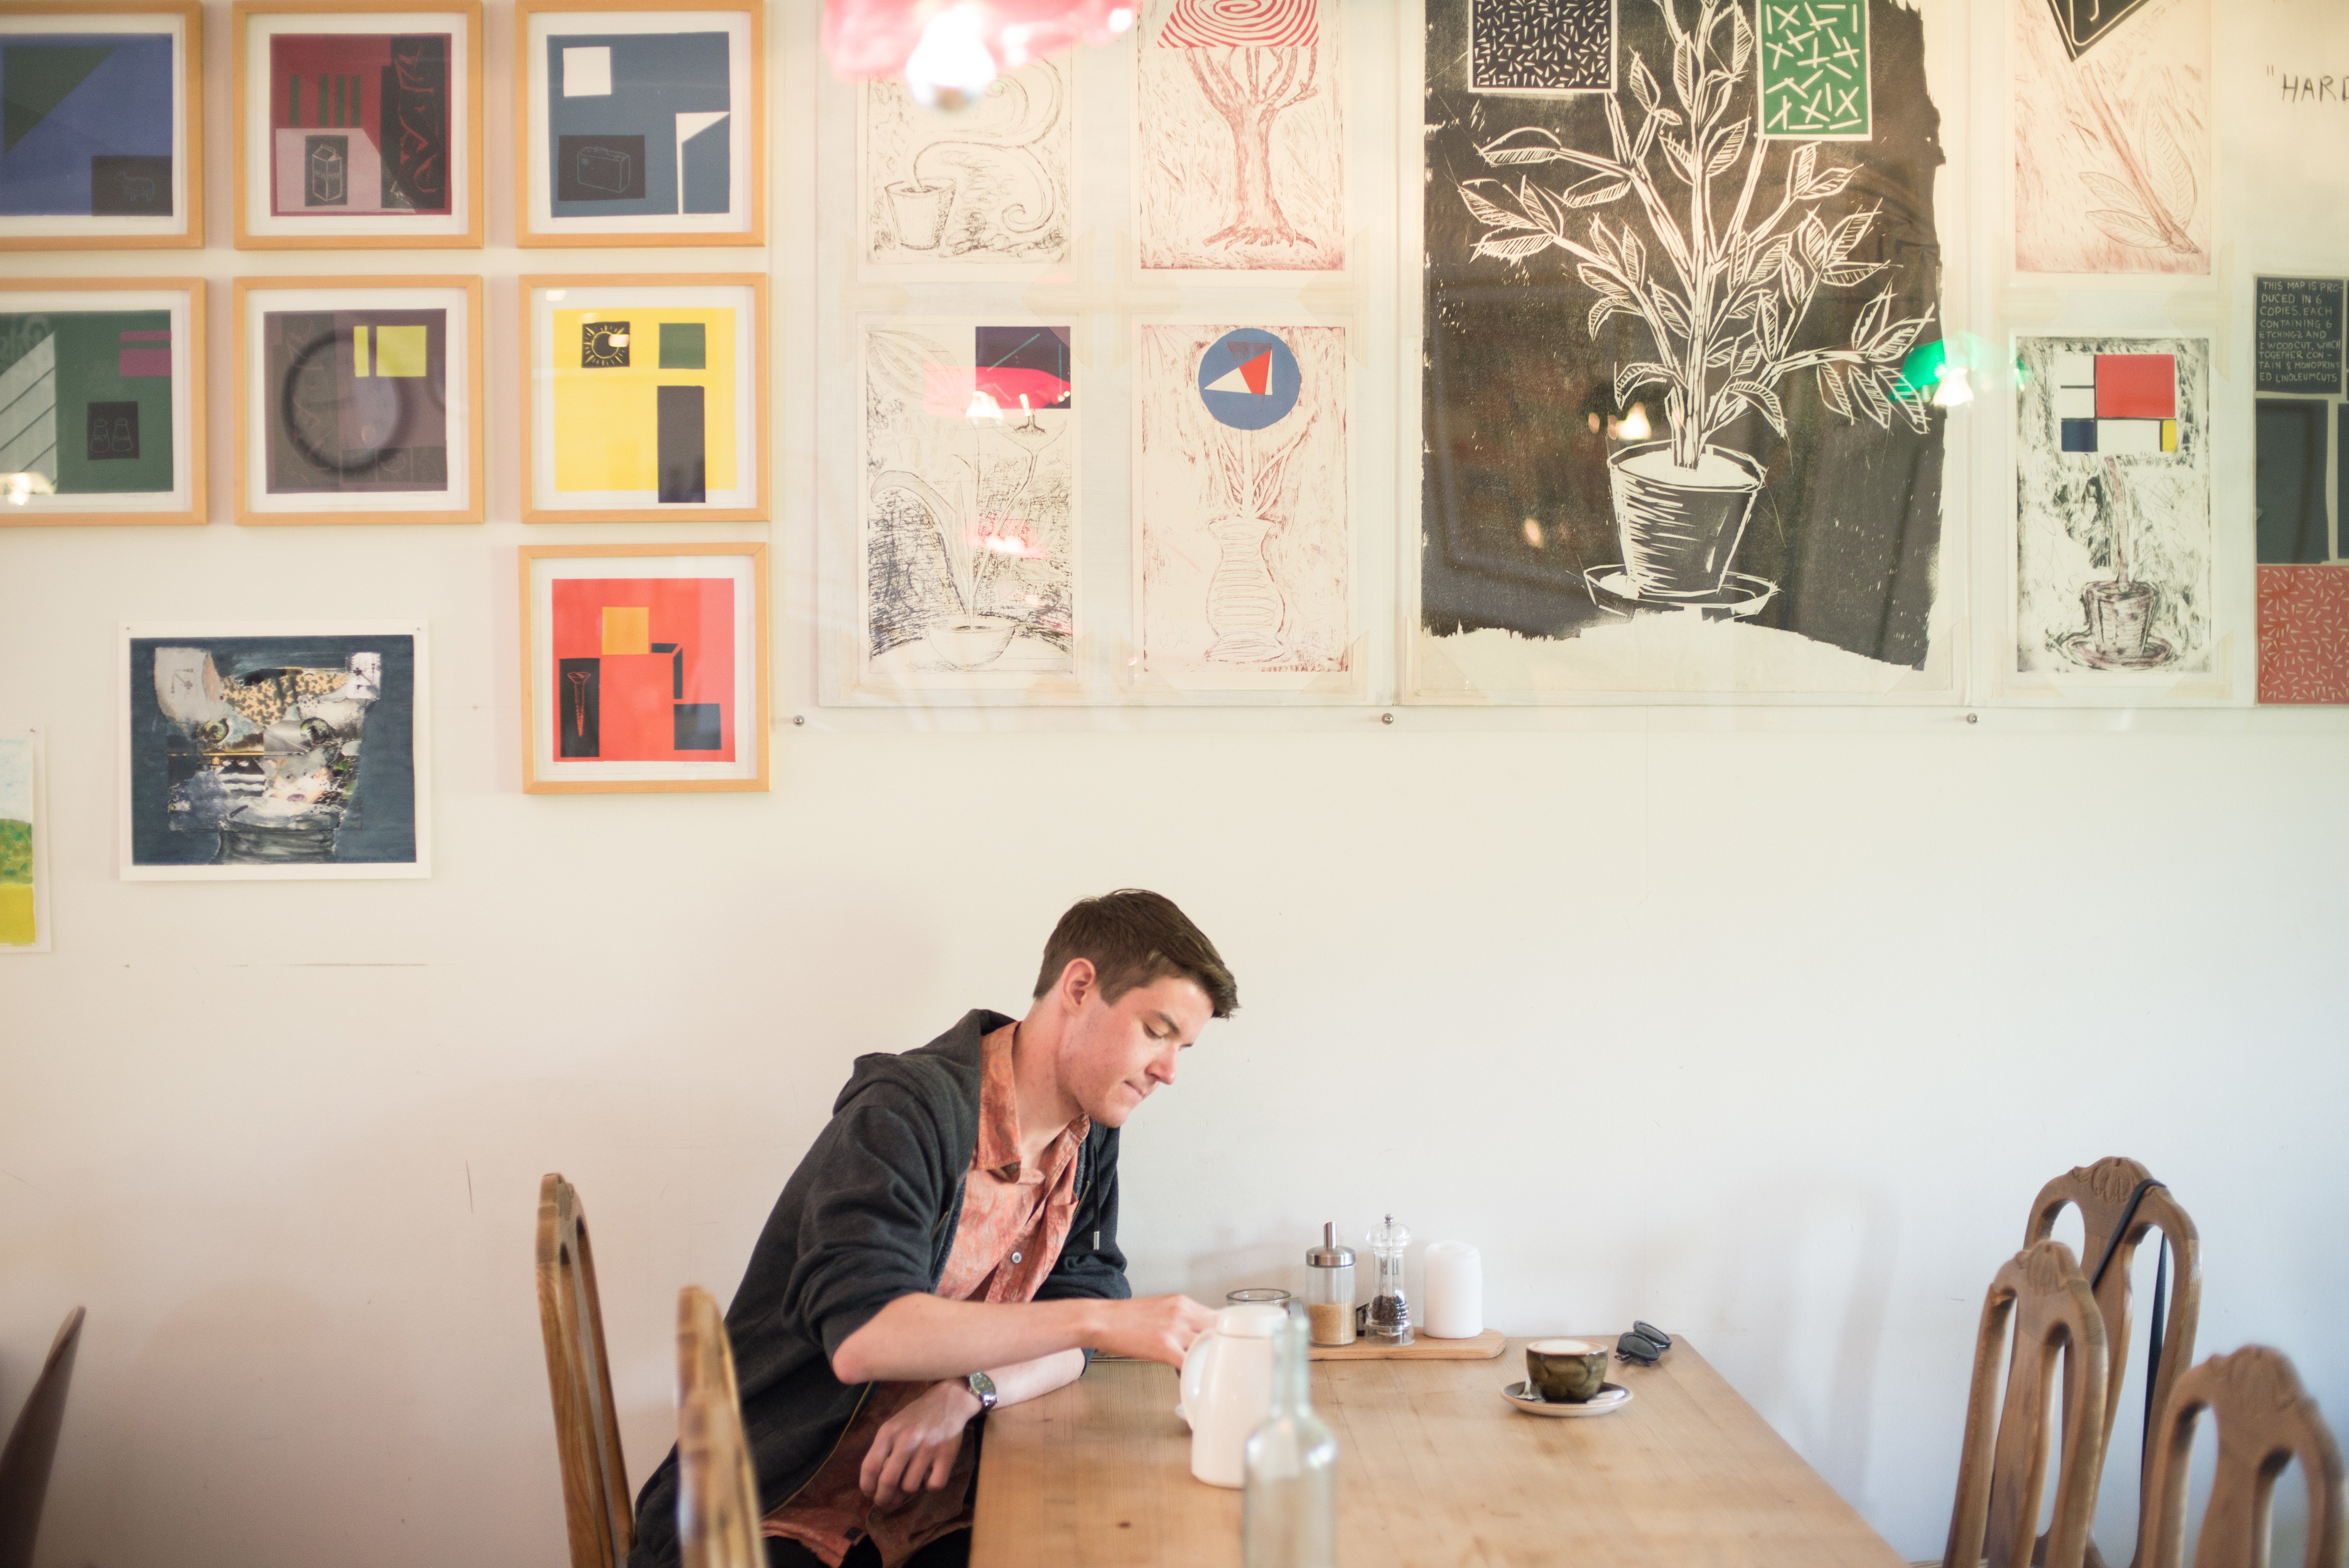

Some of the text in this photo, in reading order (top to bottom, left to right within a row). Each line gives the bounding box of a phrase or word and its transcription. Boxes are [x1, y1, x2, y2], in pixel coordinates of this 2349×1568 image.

[2263, 282, 2283, 291] THIS
[2287, 281, 2305, 290] MAP
[2308, 281, 2317, 291] IS
[2262, 294, 2322, 304] DUCED IN 6
[2260, 305, 2332, 316] COPIES. EACH
[2260, 319, 2332, 328] CONTAINING 6
[2306, 330, 2327, 339] AND
[2317, 340, 2341, 350] WHICH
[2259, 351, 2303, 359] TOGETHER
[2258, 362, 2281, 370] TAIN
[2260, 372, 2338, 383] ED LINOLEUMCUTS
